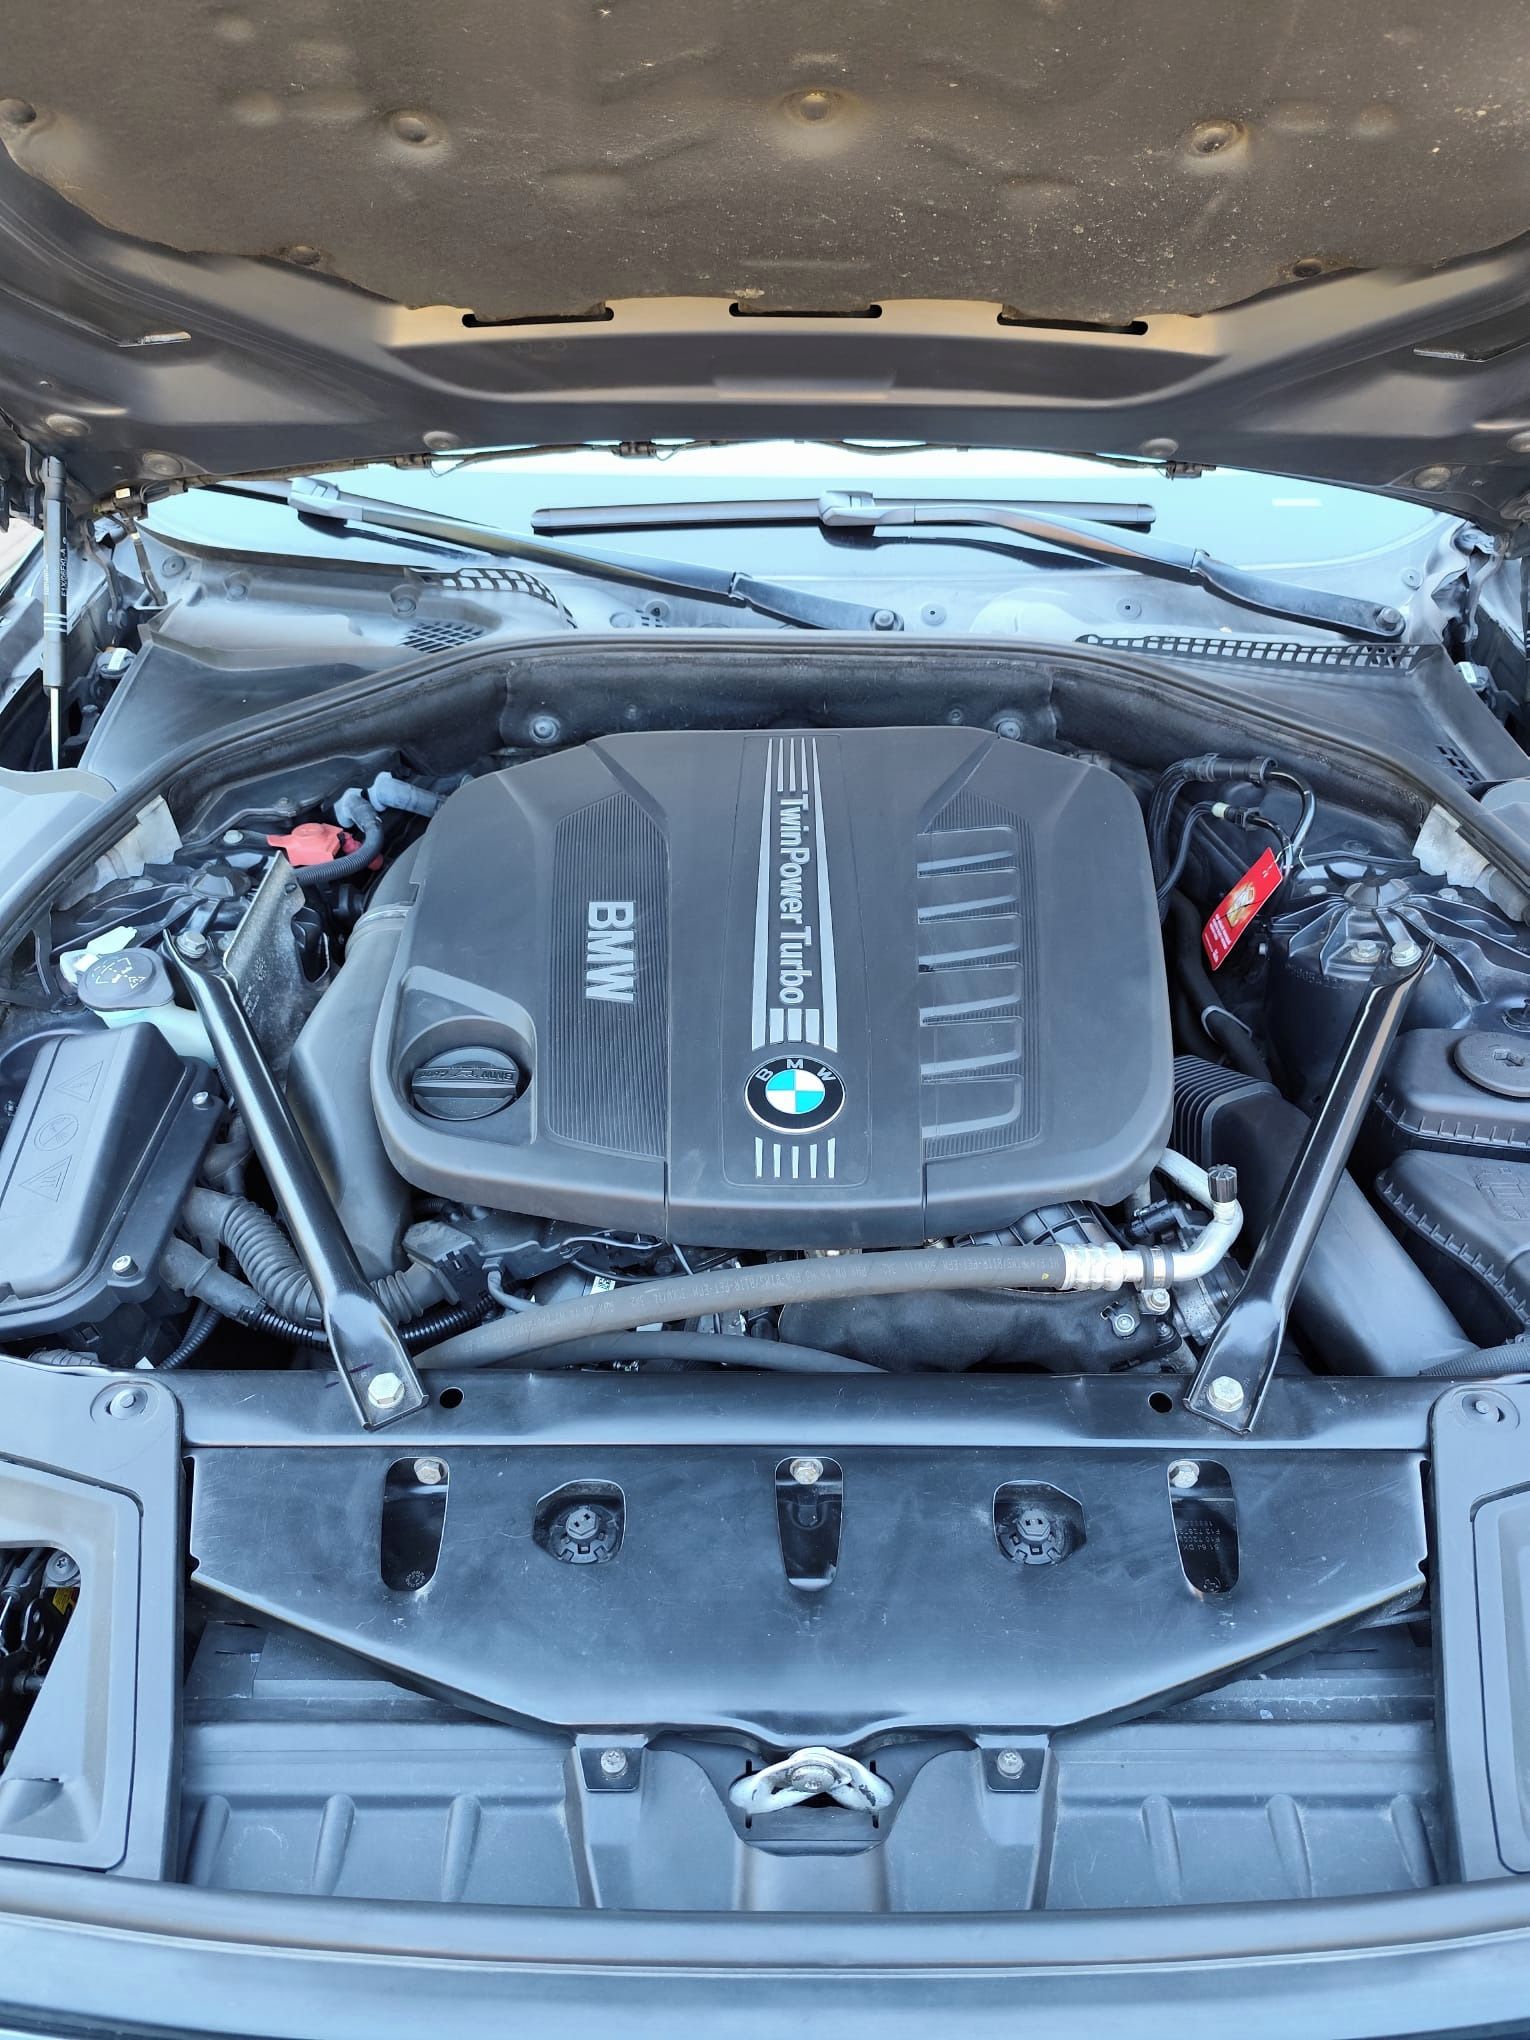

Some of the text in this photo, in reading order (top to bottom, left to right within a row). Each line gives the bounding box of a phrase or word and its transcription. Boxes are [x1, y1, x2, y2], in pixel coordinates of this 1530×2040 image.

[779, 794, 812, 1004] TwinPower Turbo
[585, 900, 636, 1003] BMW
[755, 1057, 835, 1083] BMW
